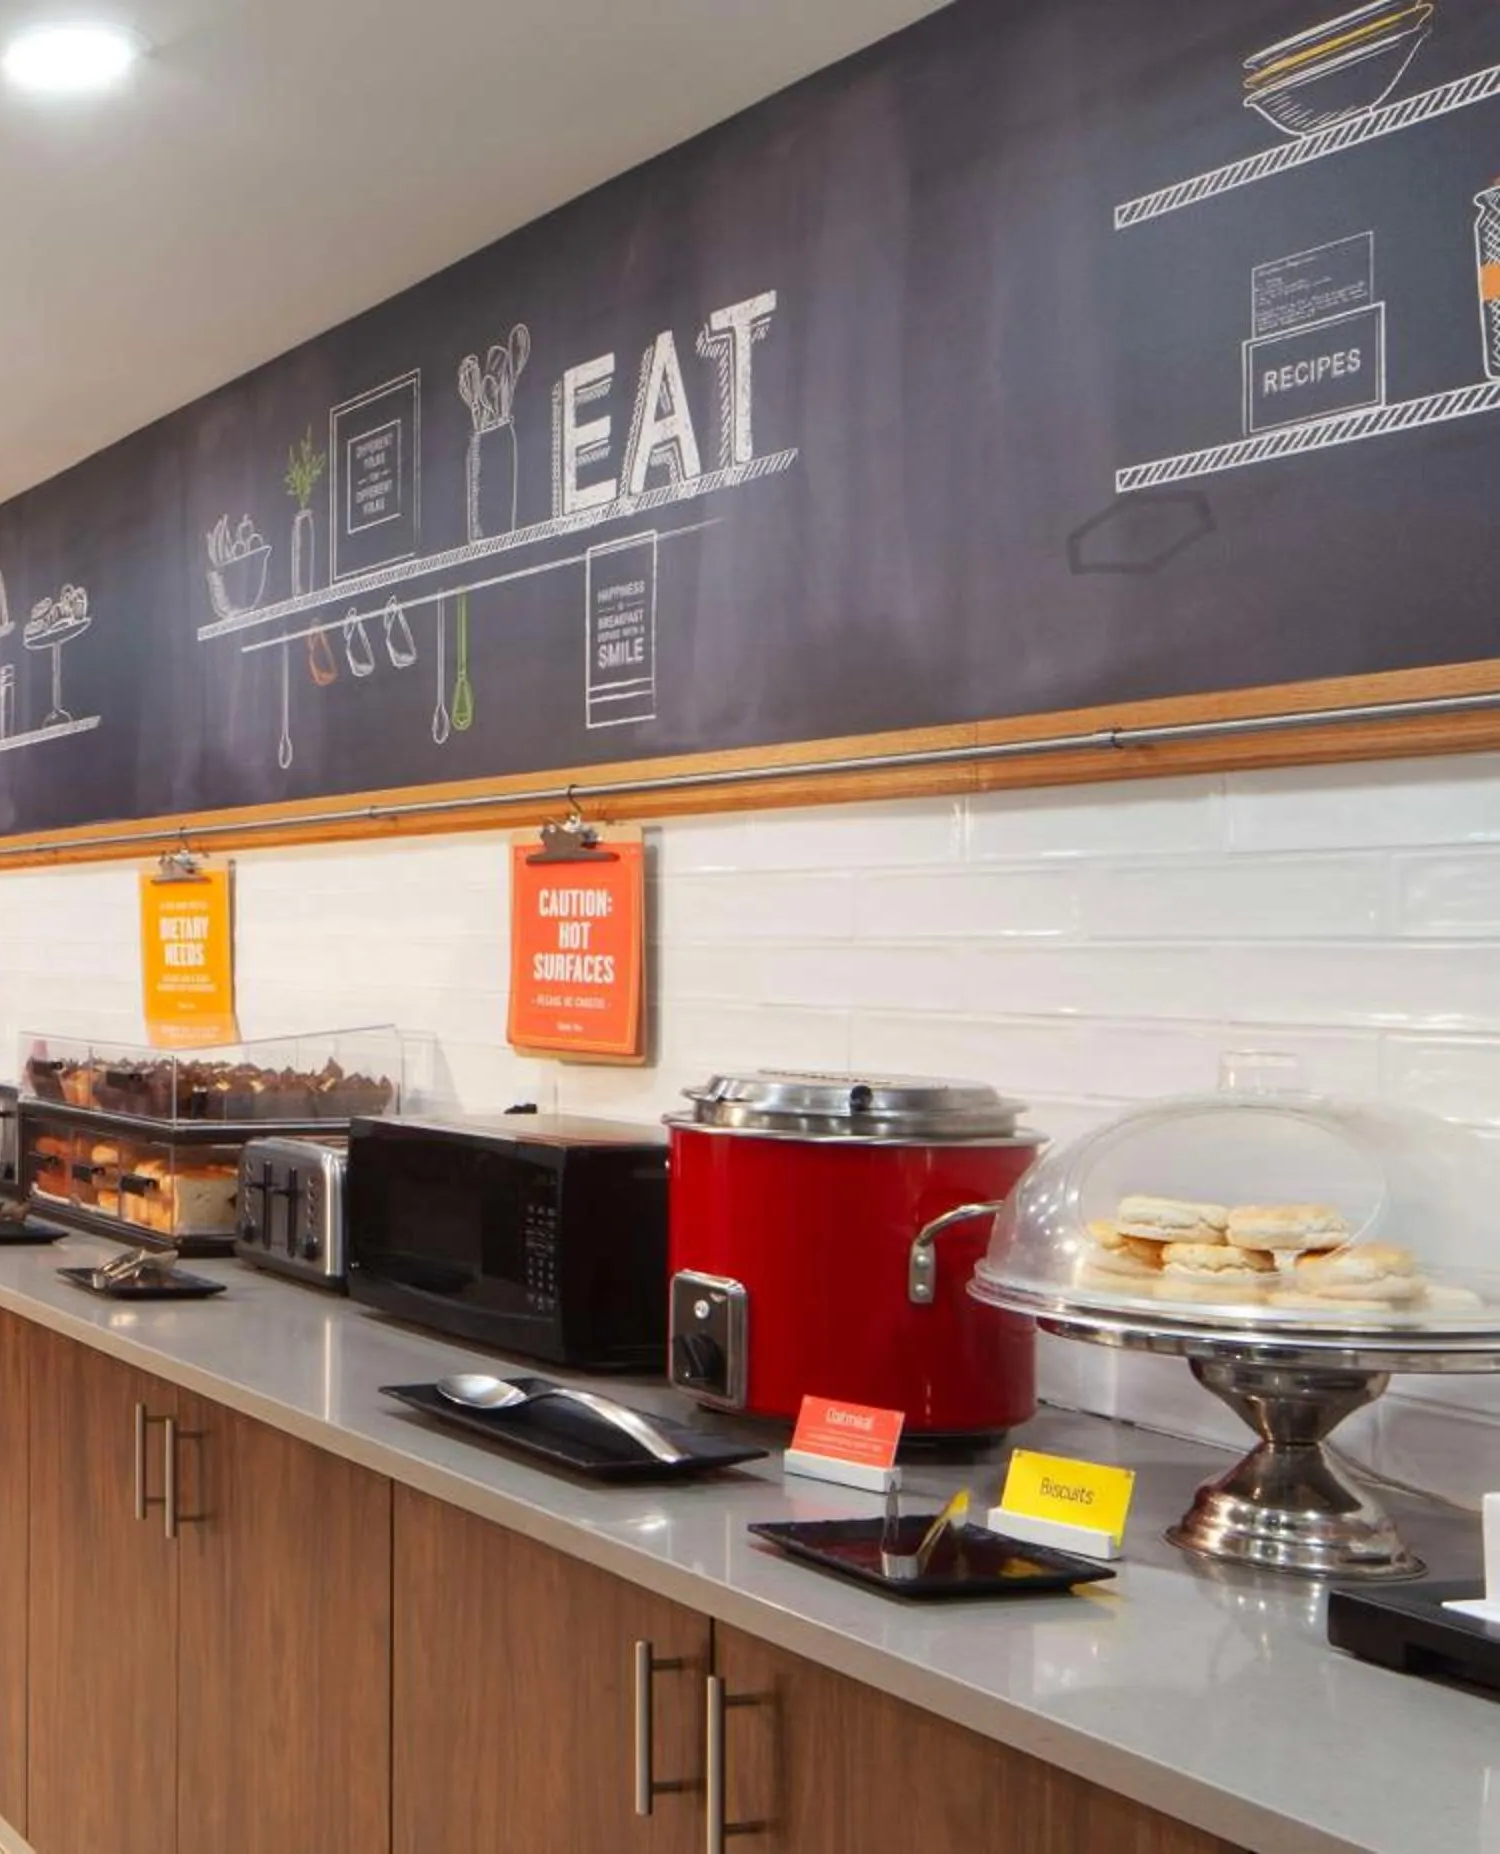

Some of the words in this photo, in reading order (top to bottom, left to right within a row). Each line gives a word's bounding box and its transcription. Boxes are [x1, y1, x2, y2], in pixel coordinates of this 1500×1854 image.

[1264, 349, 1361, 396] RECIPES
[553, 289, 777, 516] EAT
[597, 580, 645, 604] HAPPINESS
[598, 608, 644, 630] BREAKFAST
[598, 637, 644, 669] SMILE
[538, 888, 613, 917] CAUTION:
[160, 916, 210, 940] DIETARY
[558, 921, 592, 950] HOT
[165, 942, 206, 967] NEEDS
[533, 953, 615, 984] SURFACES
[1040, 1476, 1096, 1506] Biscuits
